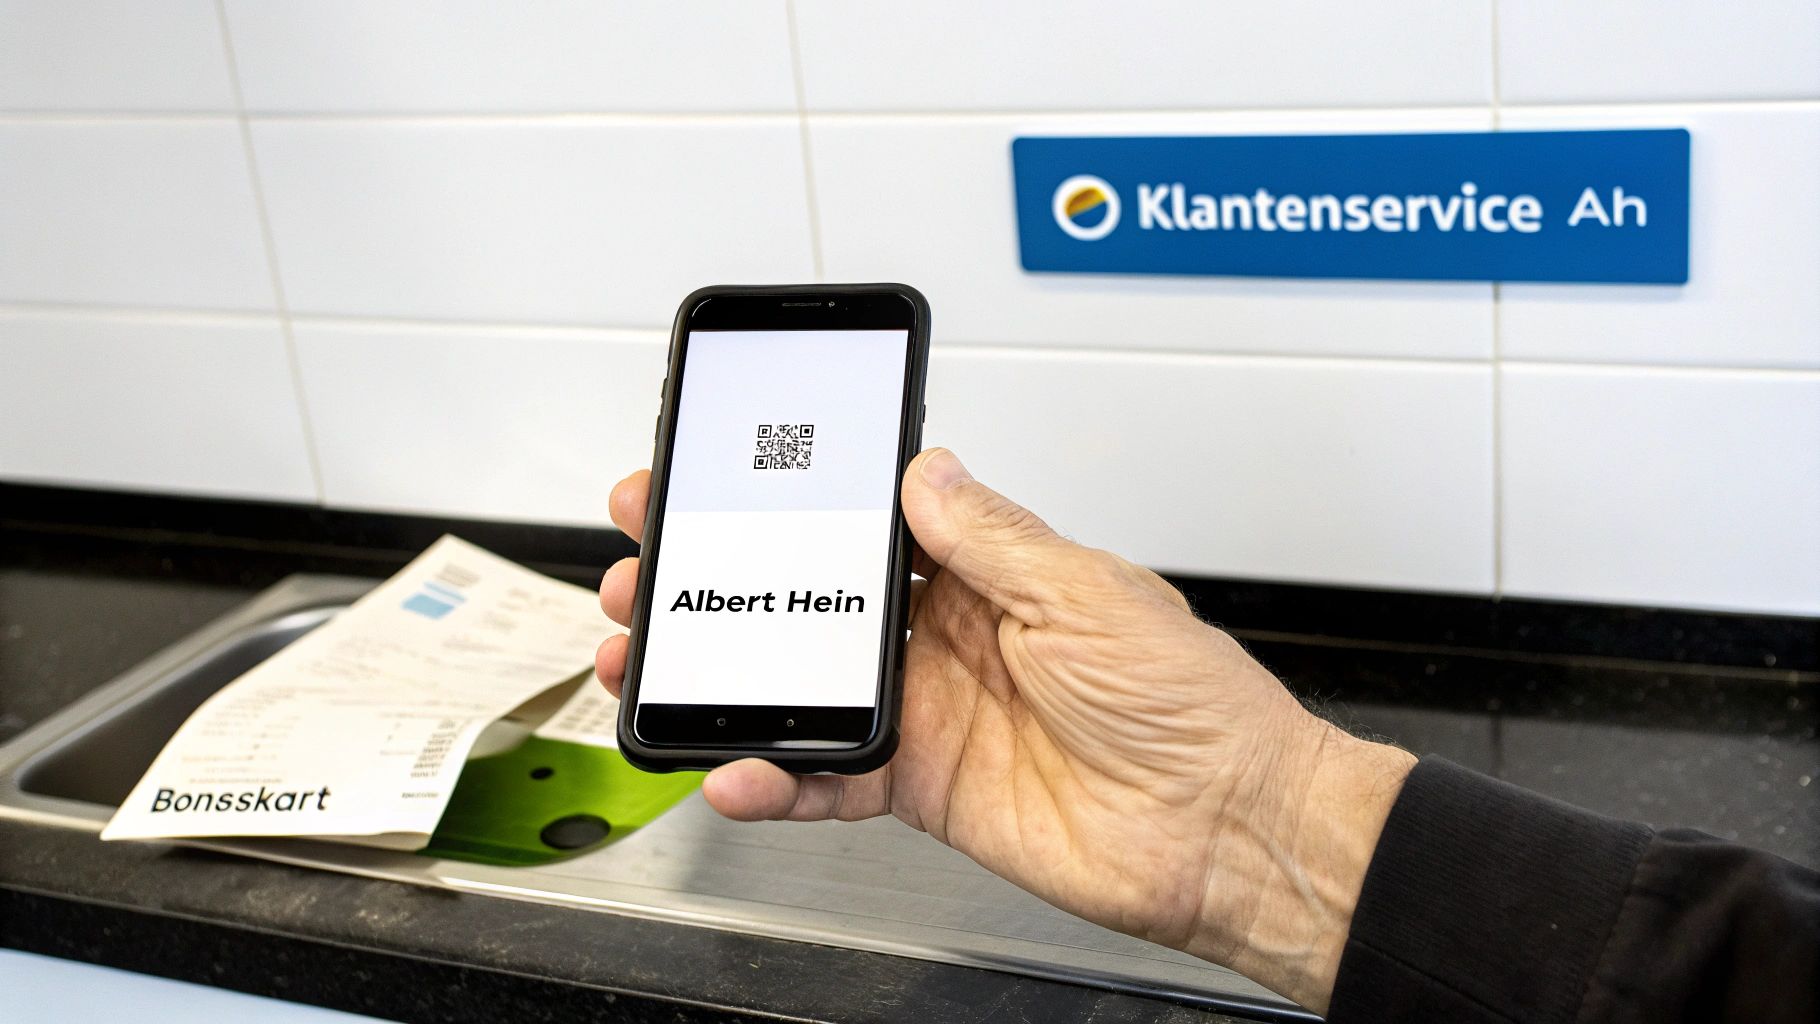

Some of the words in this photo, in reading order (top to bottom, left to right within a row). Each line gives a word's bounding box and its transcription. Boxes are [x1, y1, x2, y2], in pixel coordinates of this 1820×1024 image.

[1137, 182, 1543, 233] Klantenservice
[1568, 186, 1648, 226] Ah
[669, 589, 776, 613] Albert
[787, 589, 865, 613] Hein
[151, 786, 330, 813] Bonsskart
